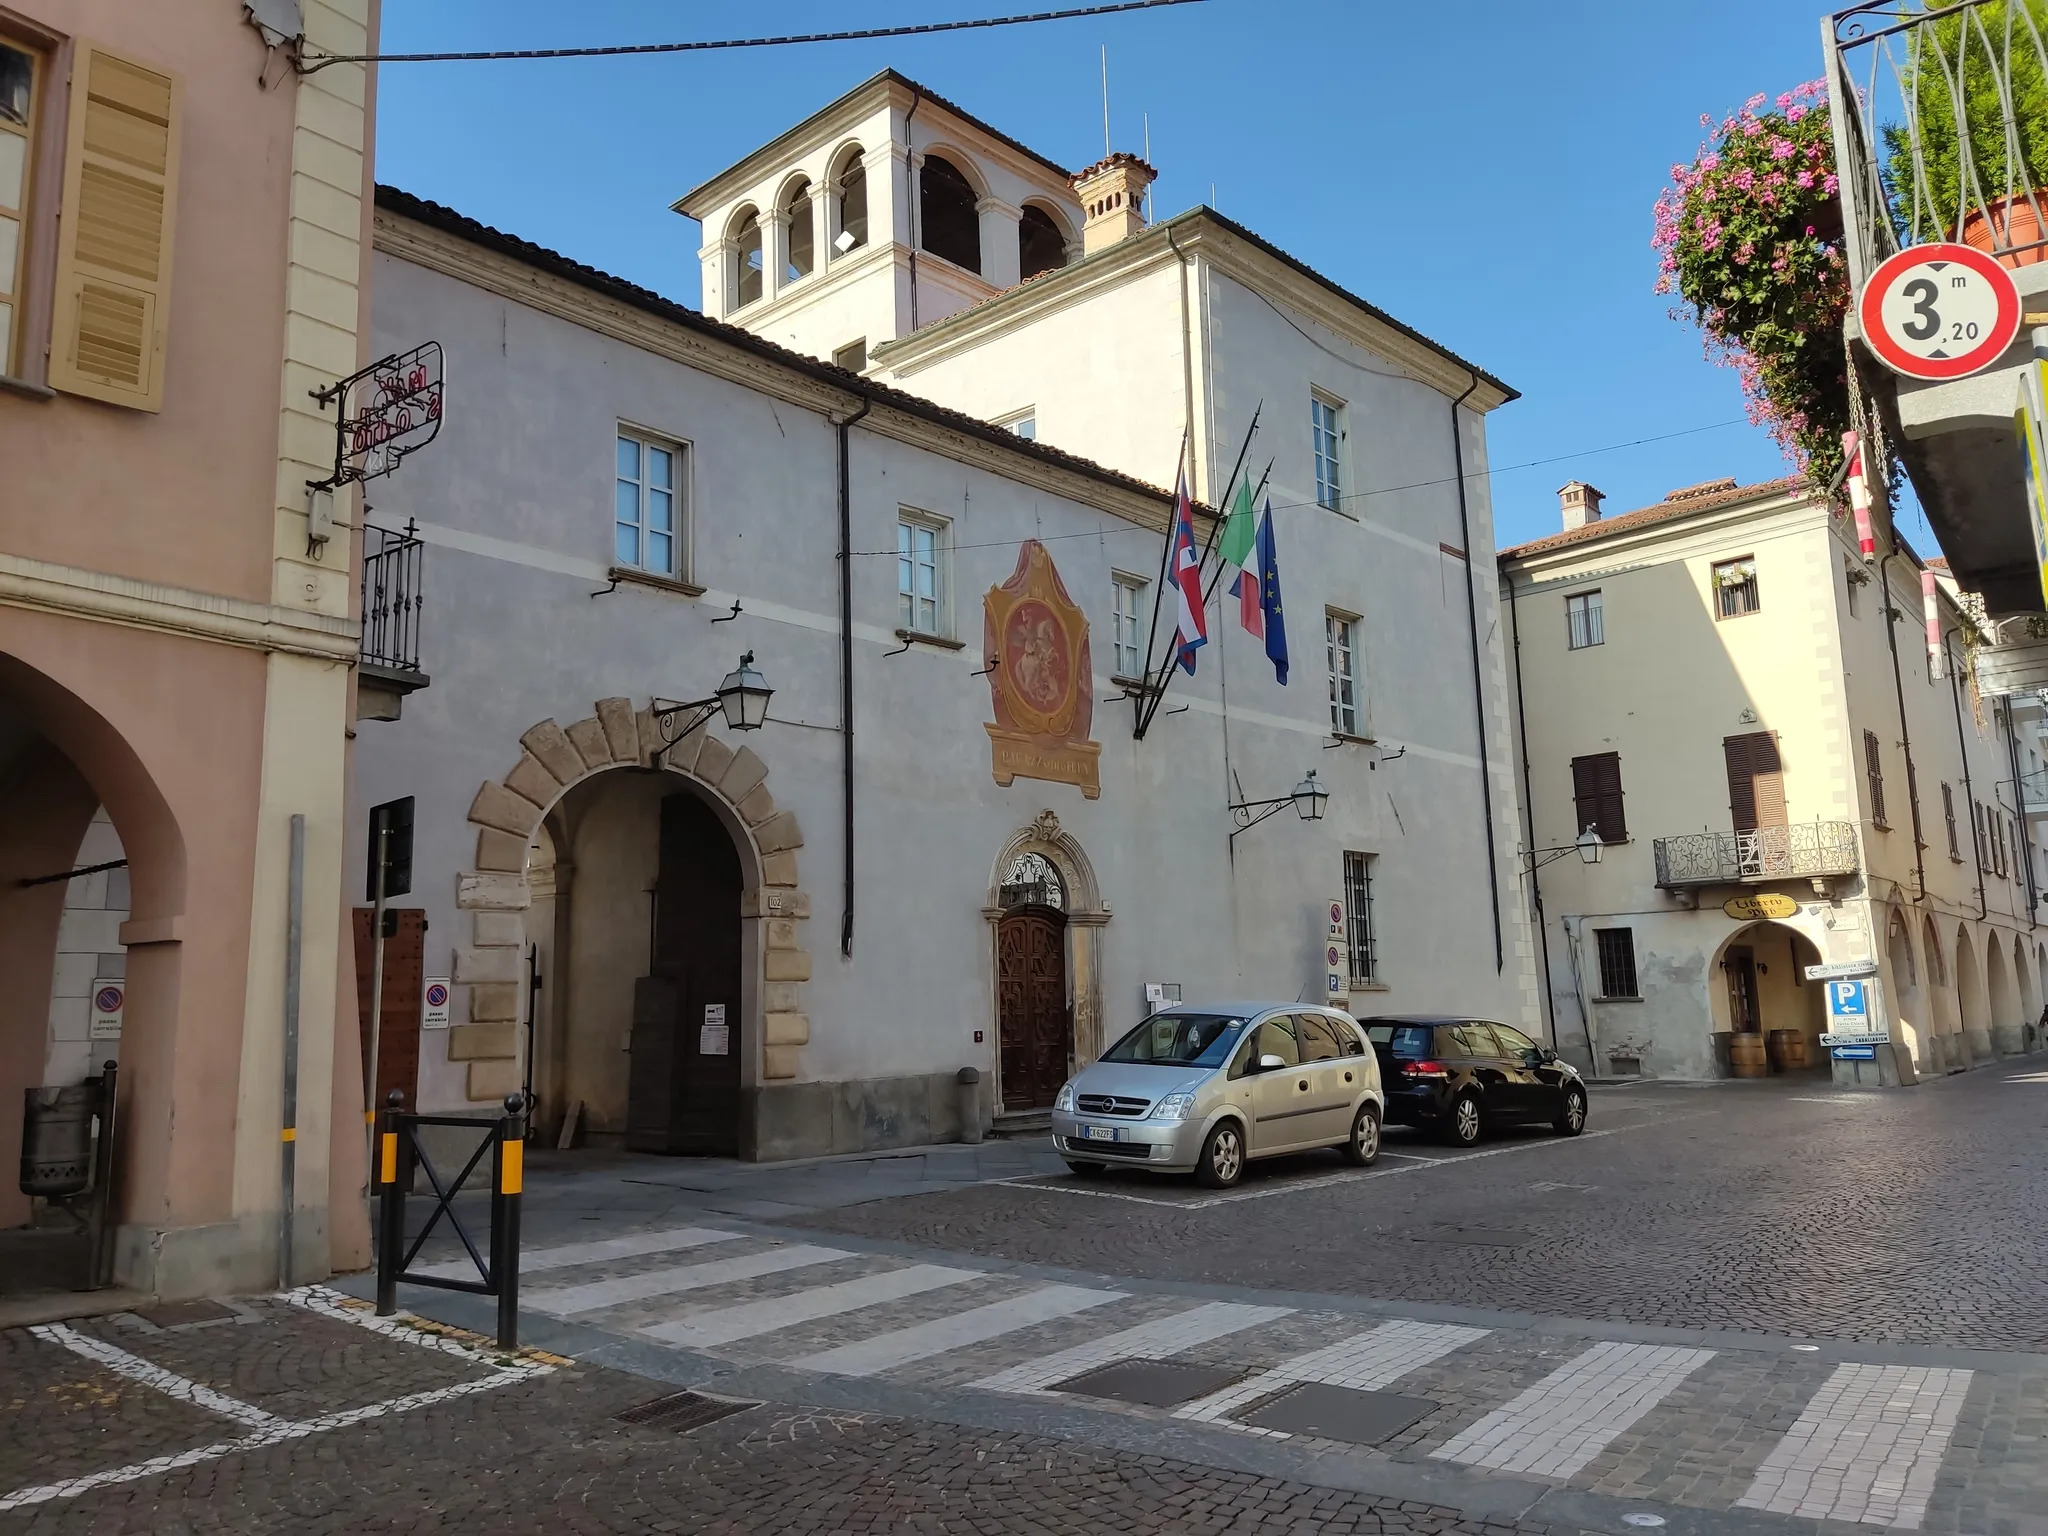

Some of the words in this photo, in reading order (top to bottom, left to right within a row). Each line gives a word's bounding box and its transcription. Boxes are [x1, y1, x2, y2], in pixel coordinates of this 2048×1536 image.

[1951, 276, 1967, 288] m
[1735, 899, 1782, 910] Liberty
[1747, 908, 1777, 918] Pub
[1837, 983, 1856, 1005] P
